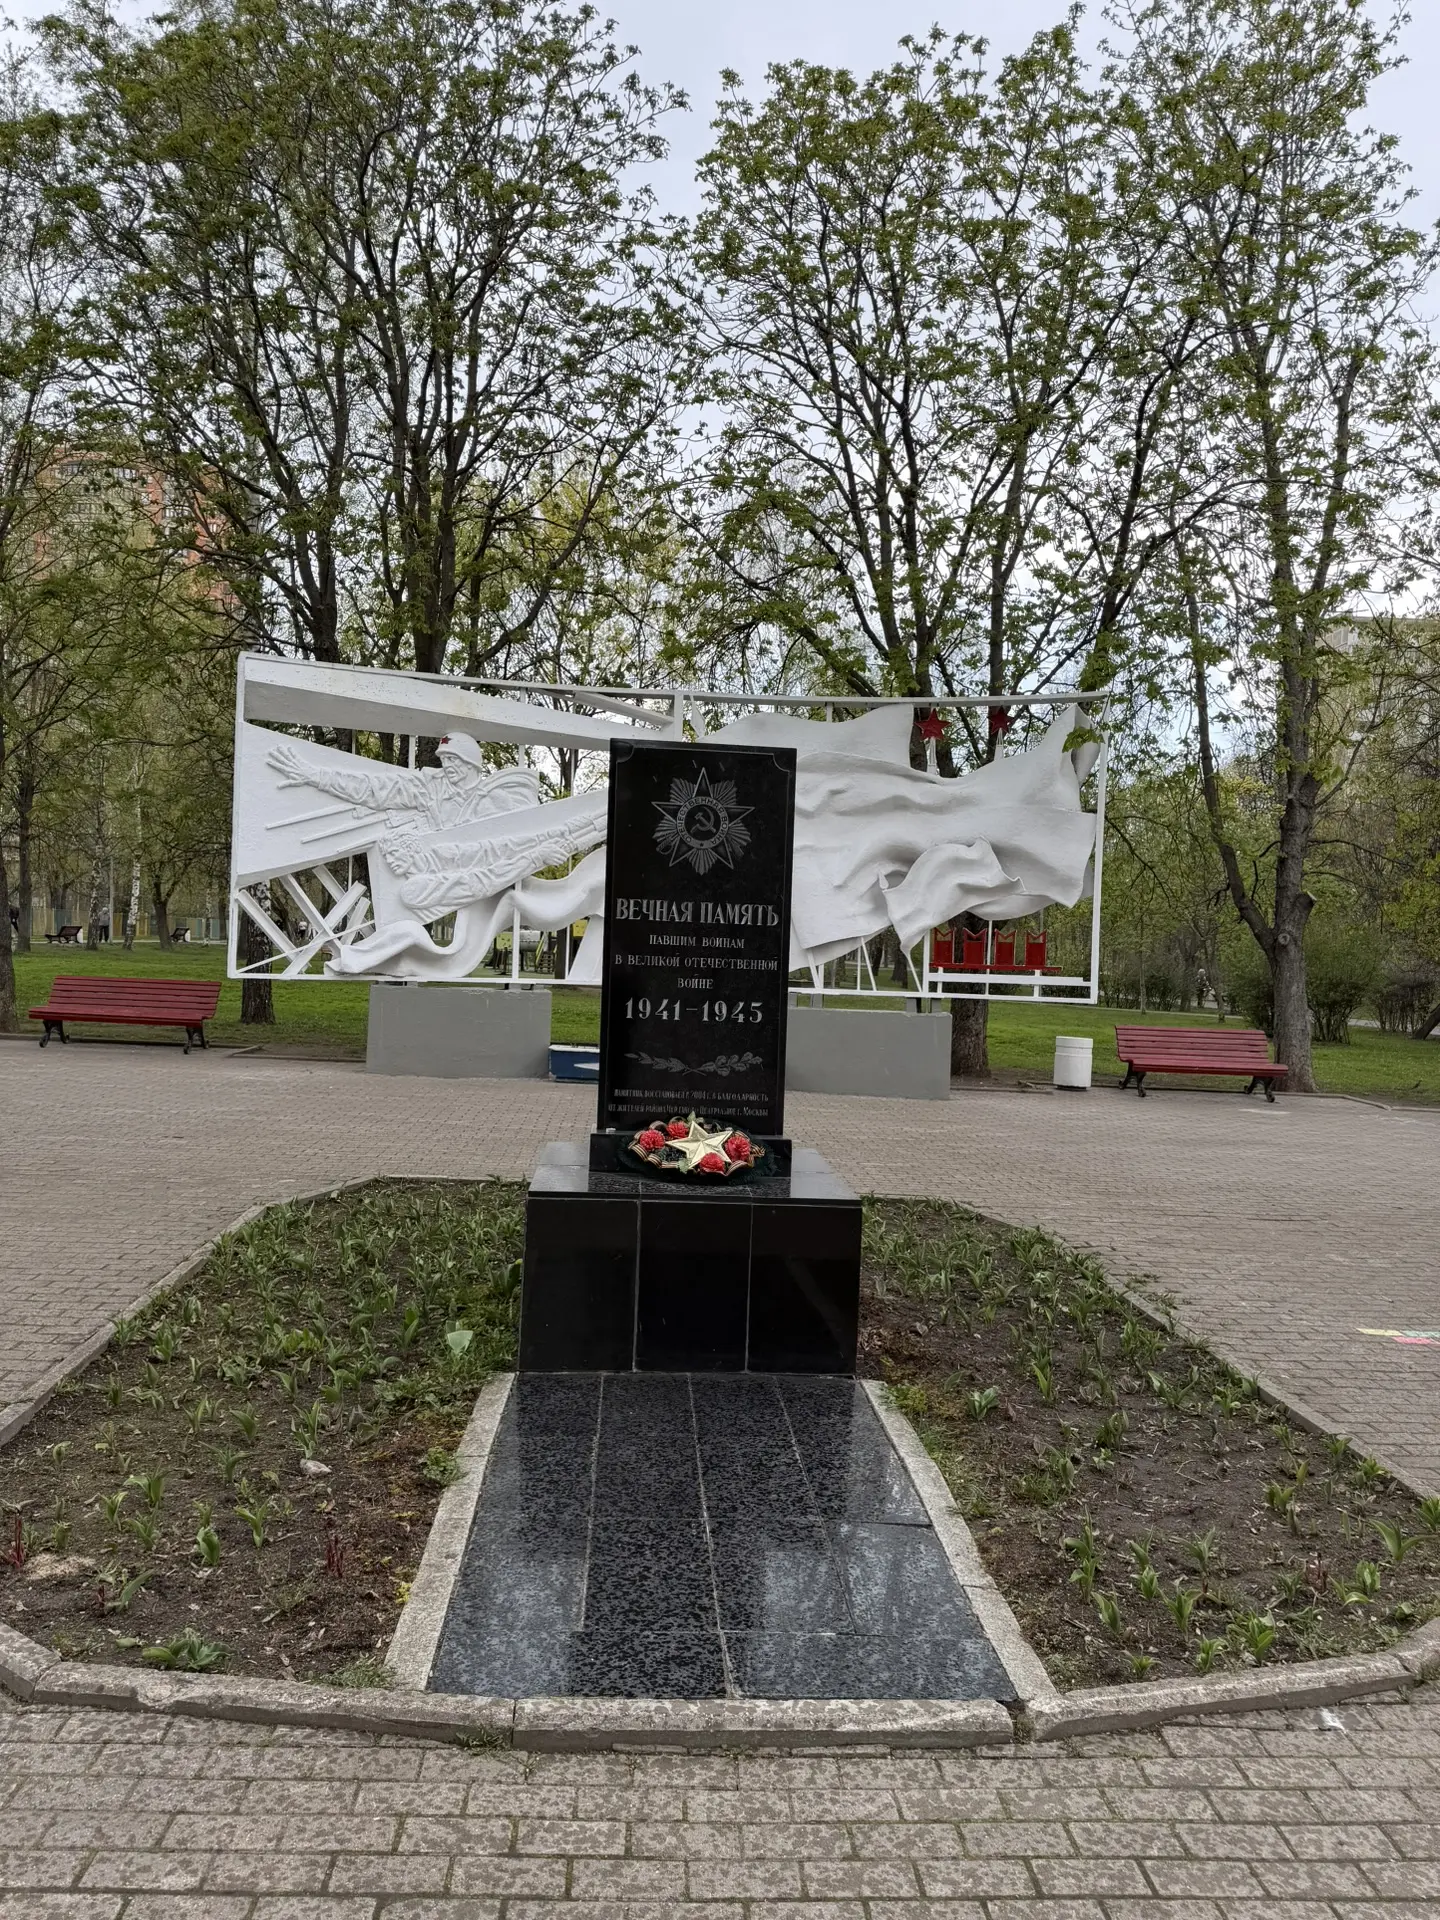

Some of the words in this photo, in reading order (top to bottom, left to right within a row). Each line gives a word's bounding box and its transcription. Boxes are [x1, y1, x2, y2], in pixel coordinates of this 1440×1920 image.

[615, 898, 694, 923] ВЕЧНАЯ
[700, 901, 779, 927] ПАМЯТЬ
[649, 934, 696, 947] ПАВШИМ
[702, 937, 745, 949] ВОИНАМ
[615, 954, 622, 965] В
[628, 953, 680, 967] ВЕЛИКОЙ
[684, 956, 778, 971] ОТЕЧЕСТВЕННОЙ
[677, 974, 714, 989] ВОЙНЕ
